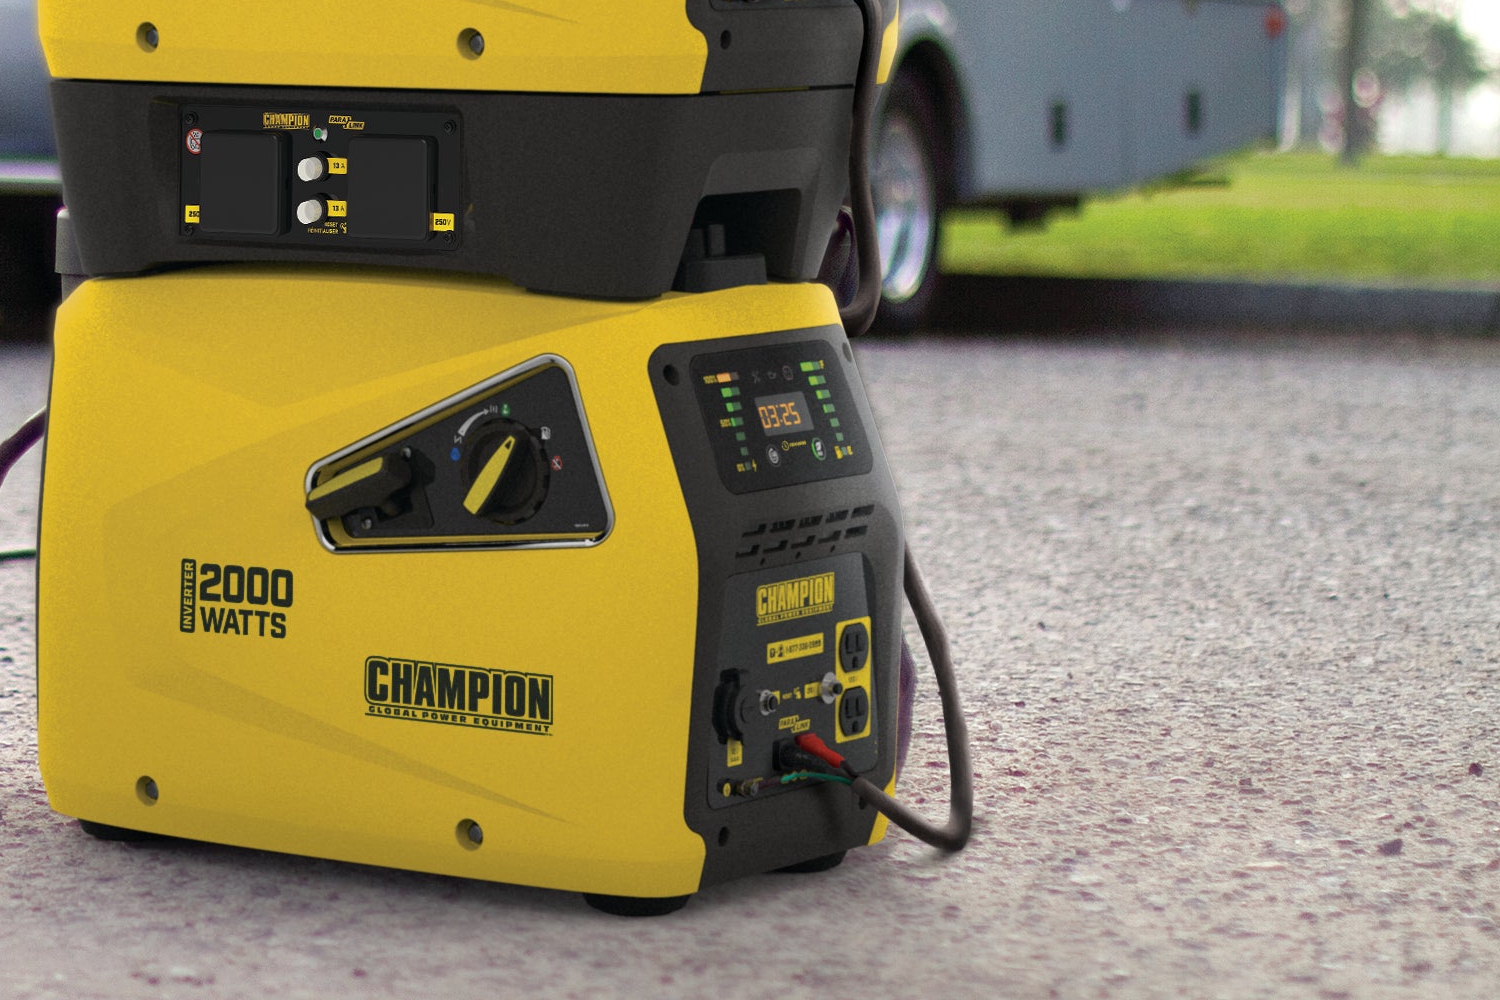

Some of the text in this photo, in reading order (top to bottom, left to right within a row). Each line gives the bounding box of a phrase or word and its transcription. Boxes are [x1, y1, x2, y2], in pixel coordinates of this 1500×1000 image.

[263, 114, 310, 126] CHAMPION
[758, 402, 801, 429] 03:25
[182, 562, 194, 630] INVERTER
[200, 563, 293, 608] 2000
[757, 574, 834, 616] CHAMPION
[200, 606, 287, 639] WATTS
[368, 659, 551, 721] CHAMPION
[368, 705, 550, 733] GLOBAL POWER EQUIPMENT
